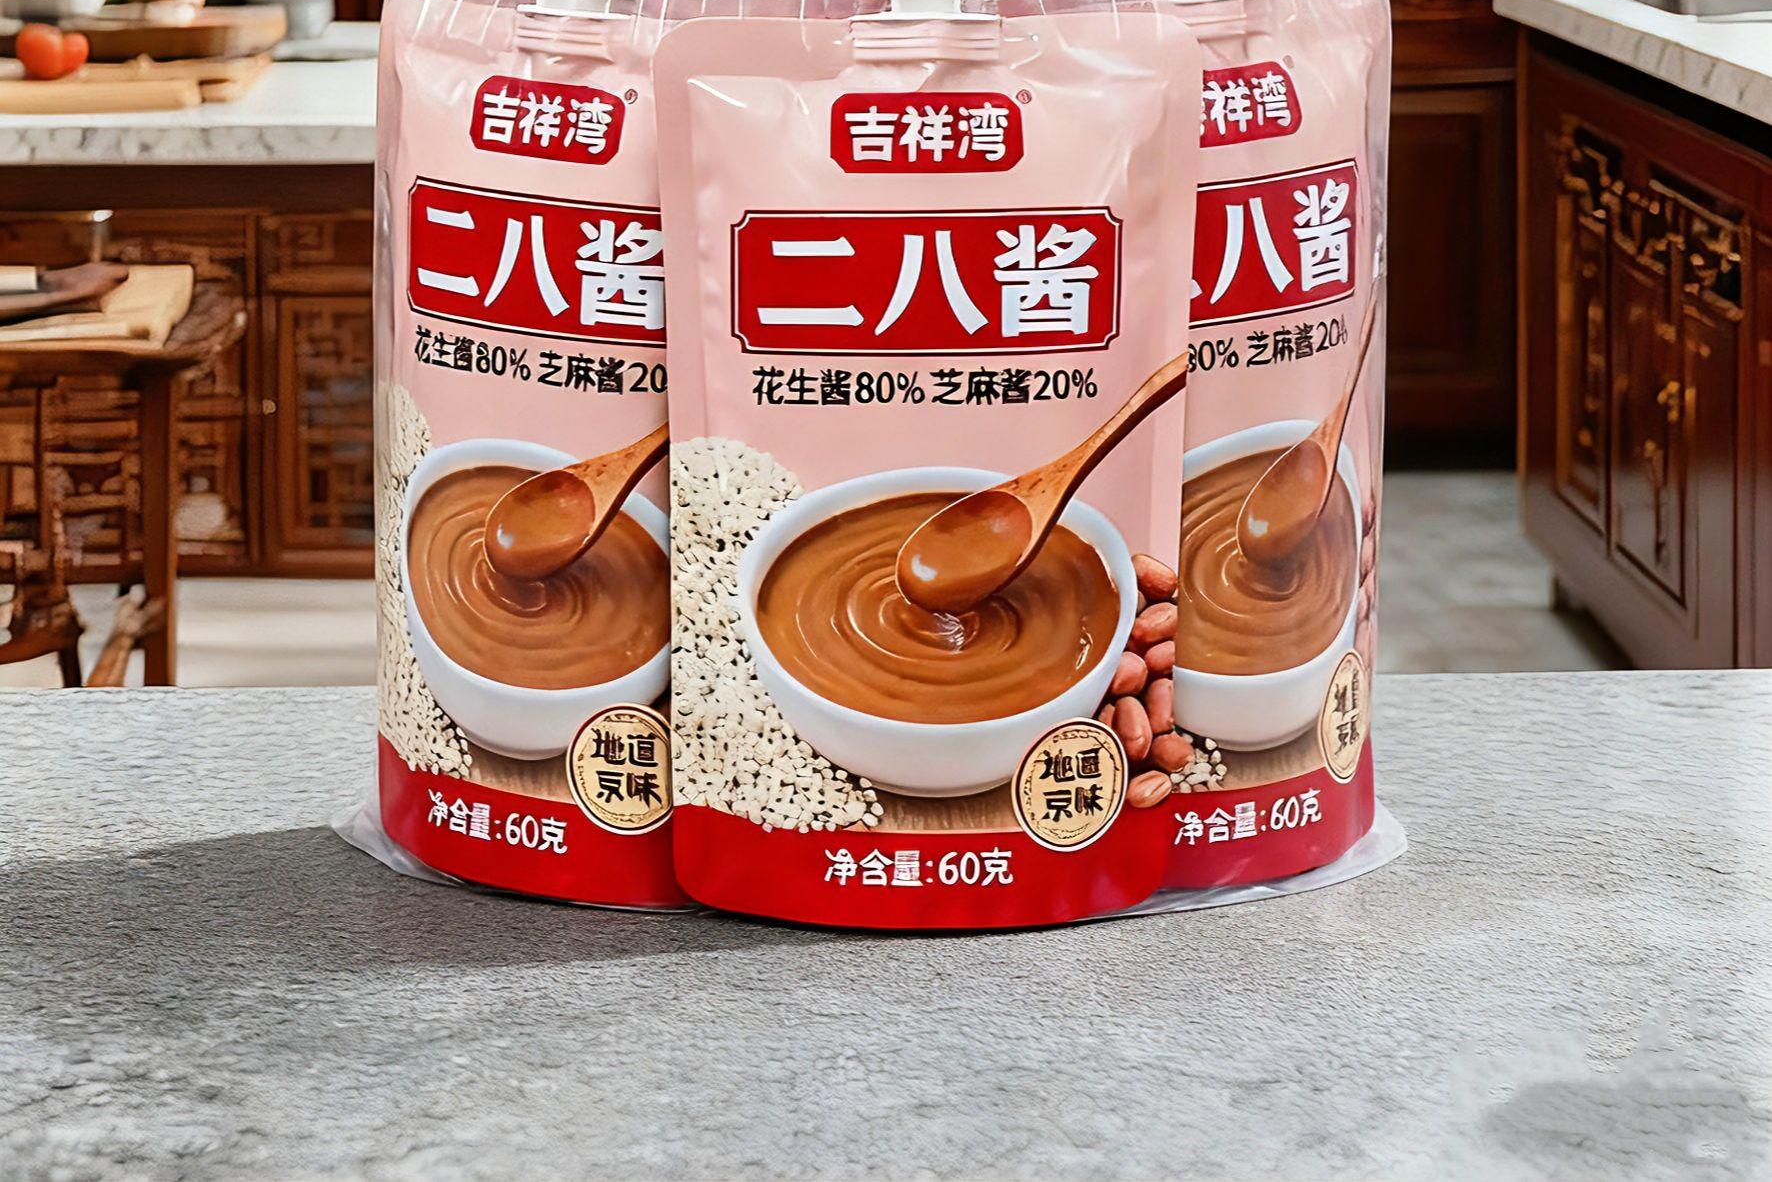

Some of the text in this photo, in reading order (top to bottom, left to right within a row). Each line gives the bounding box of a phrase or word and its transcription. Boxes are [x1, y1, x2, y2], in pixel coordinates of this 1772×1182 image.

[482, 89, 613, 155] 吉祥湾
[844, 102, 1010, 162] 吉祥湾
[1200, 72, 1291, 135] 祥湾
[417, 206, 665, 329] 二八酱
[1190, 178, 1351, 304] 八酱
[756, 223, 1099, 338] 二八酱
[752, 366, 1098, 406] 花生酱80% 芝麻酱20%
